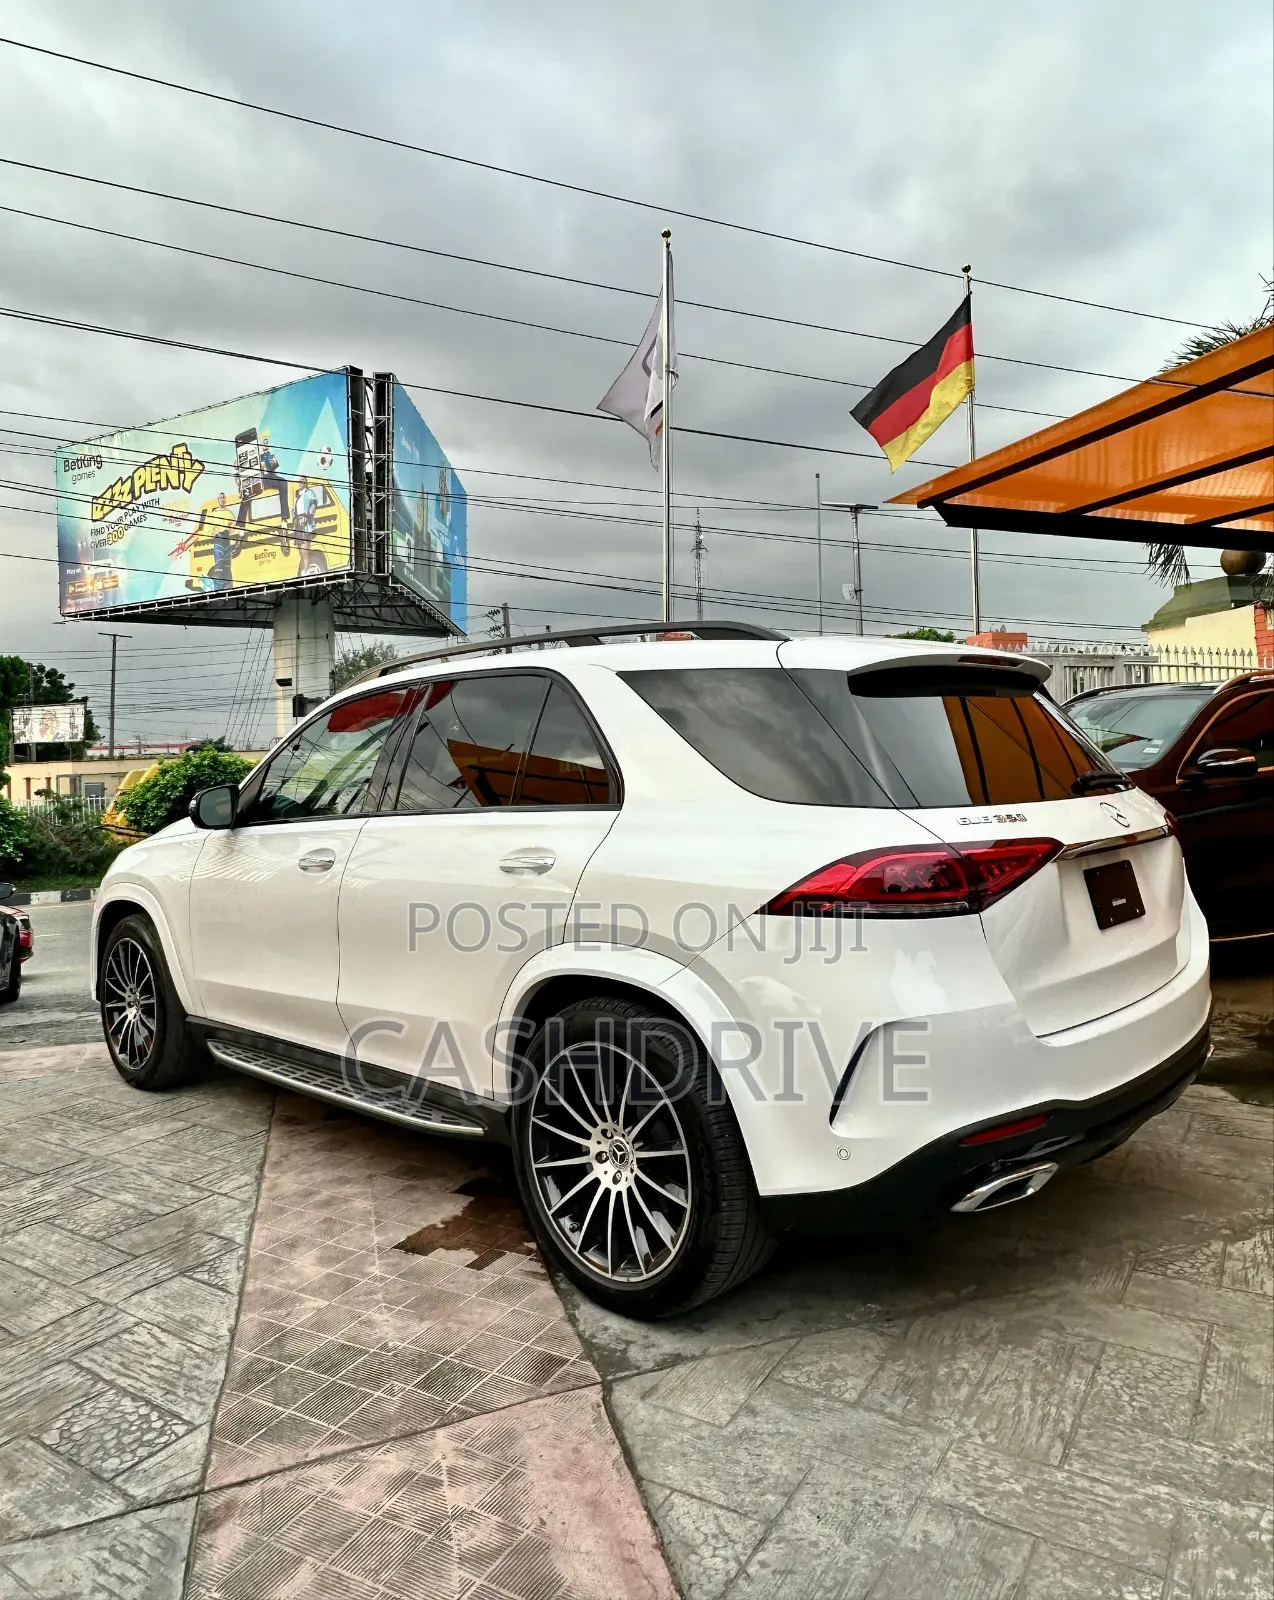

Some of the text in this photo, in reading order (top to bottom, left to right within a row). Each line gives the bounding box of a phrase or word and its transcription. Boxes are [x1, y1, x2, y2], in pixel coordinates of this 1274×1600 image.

[63, 455, 103, 473] BetKing
[132, 443, 205, 500] PLENTY
[71, 470, 96, 485] games
[141, 498, 160, 510] WITH
[956, 813, 1027, 826] GLE 350
